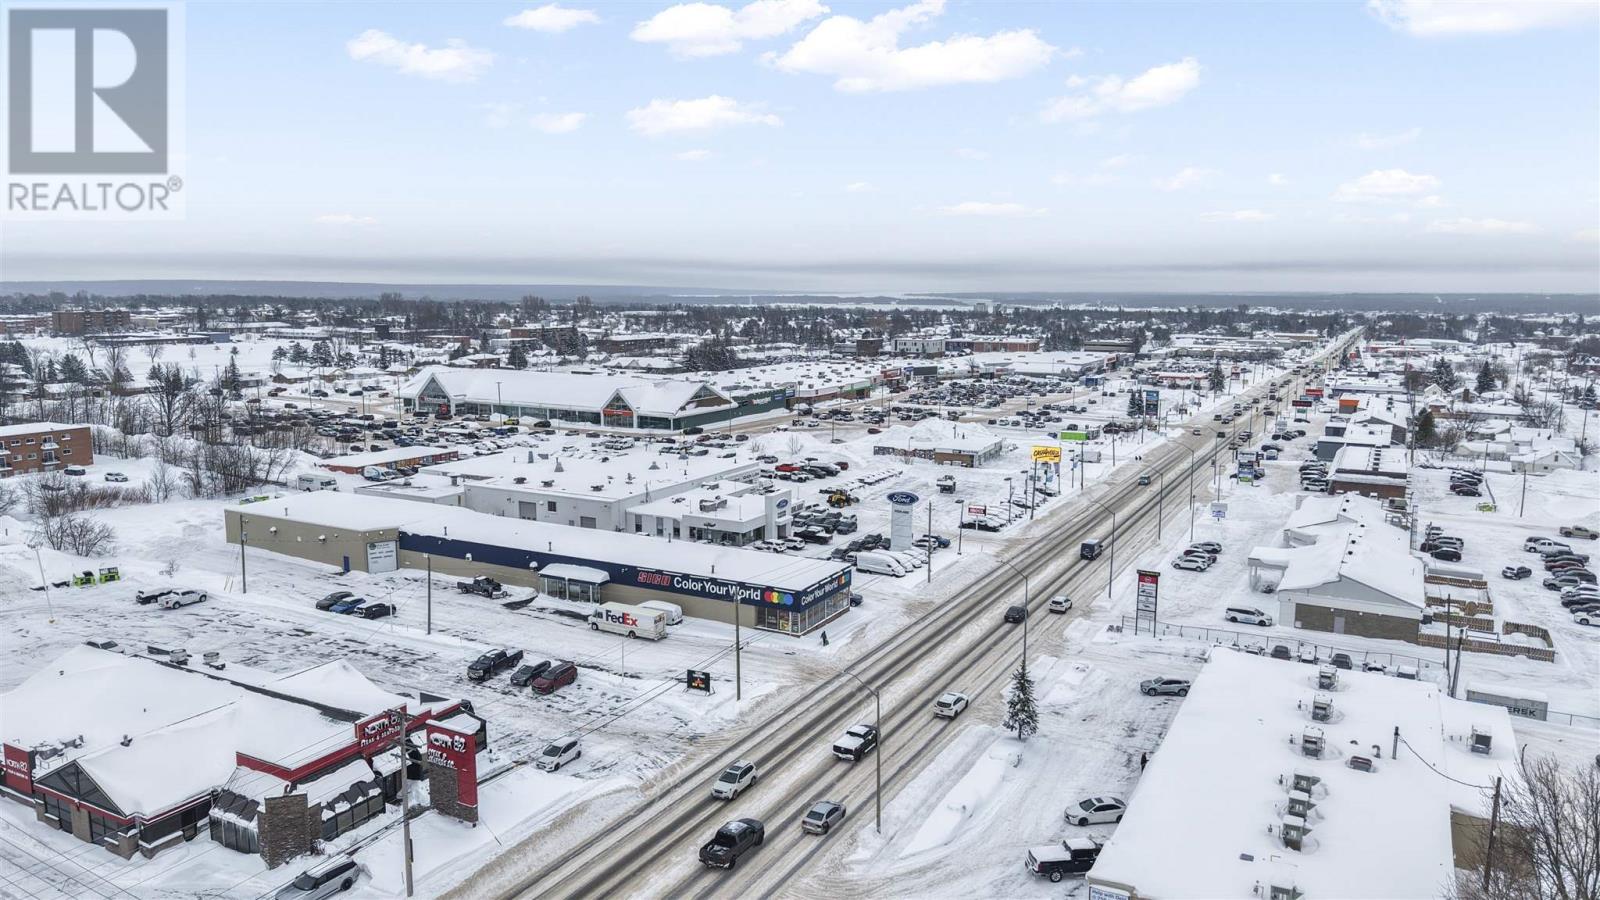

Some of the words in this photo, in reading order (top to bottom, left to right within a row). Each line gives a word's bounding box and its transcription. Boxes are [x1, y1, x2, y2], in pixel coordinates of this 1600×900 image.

[892, 493, 911, 503] Ford
[673, 576, 703, 592] Color
[703, 581, 728, 595] Your
[727, 585, 761, 600] World
[605, 609, 639, 628] FedEx
[365, 719, 390, 736] NORTH
[453, 735, 466, 753] 82
[20, 761, 28, 772] 82
